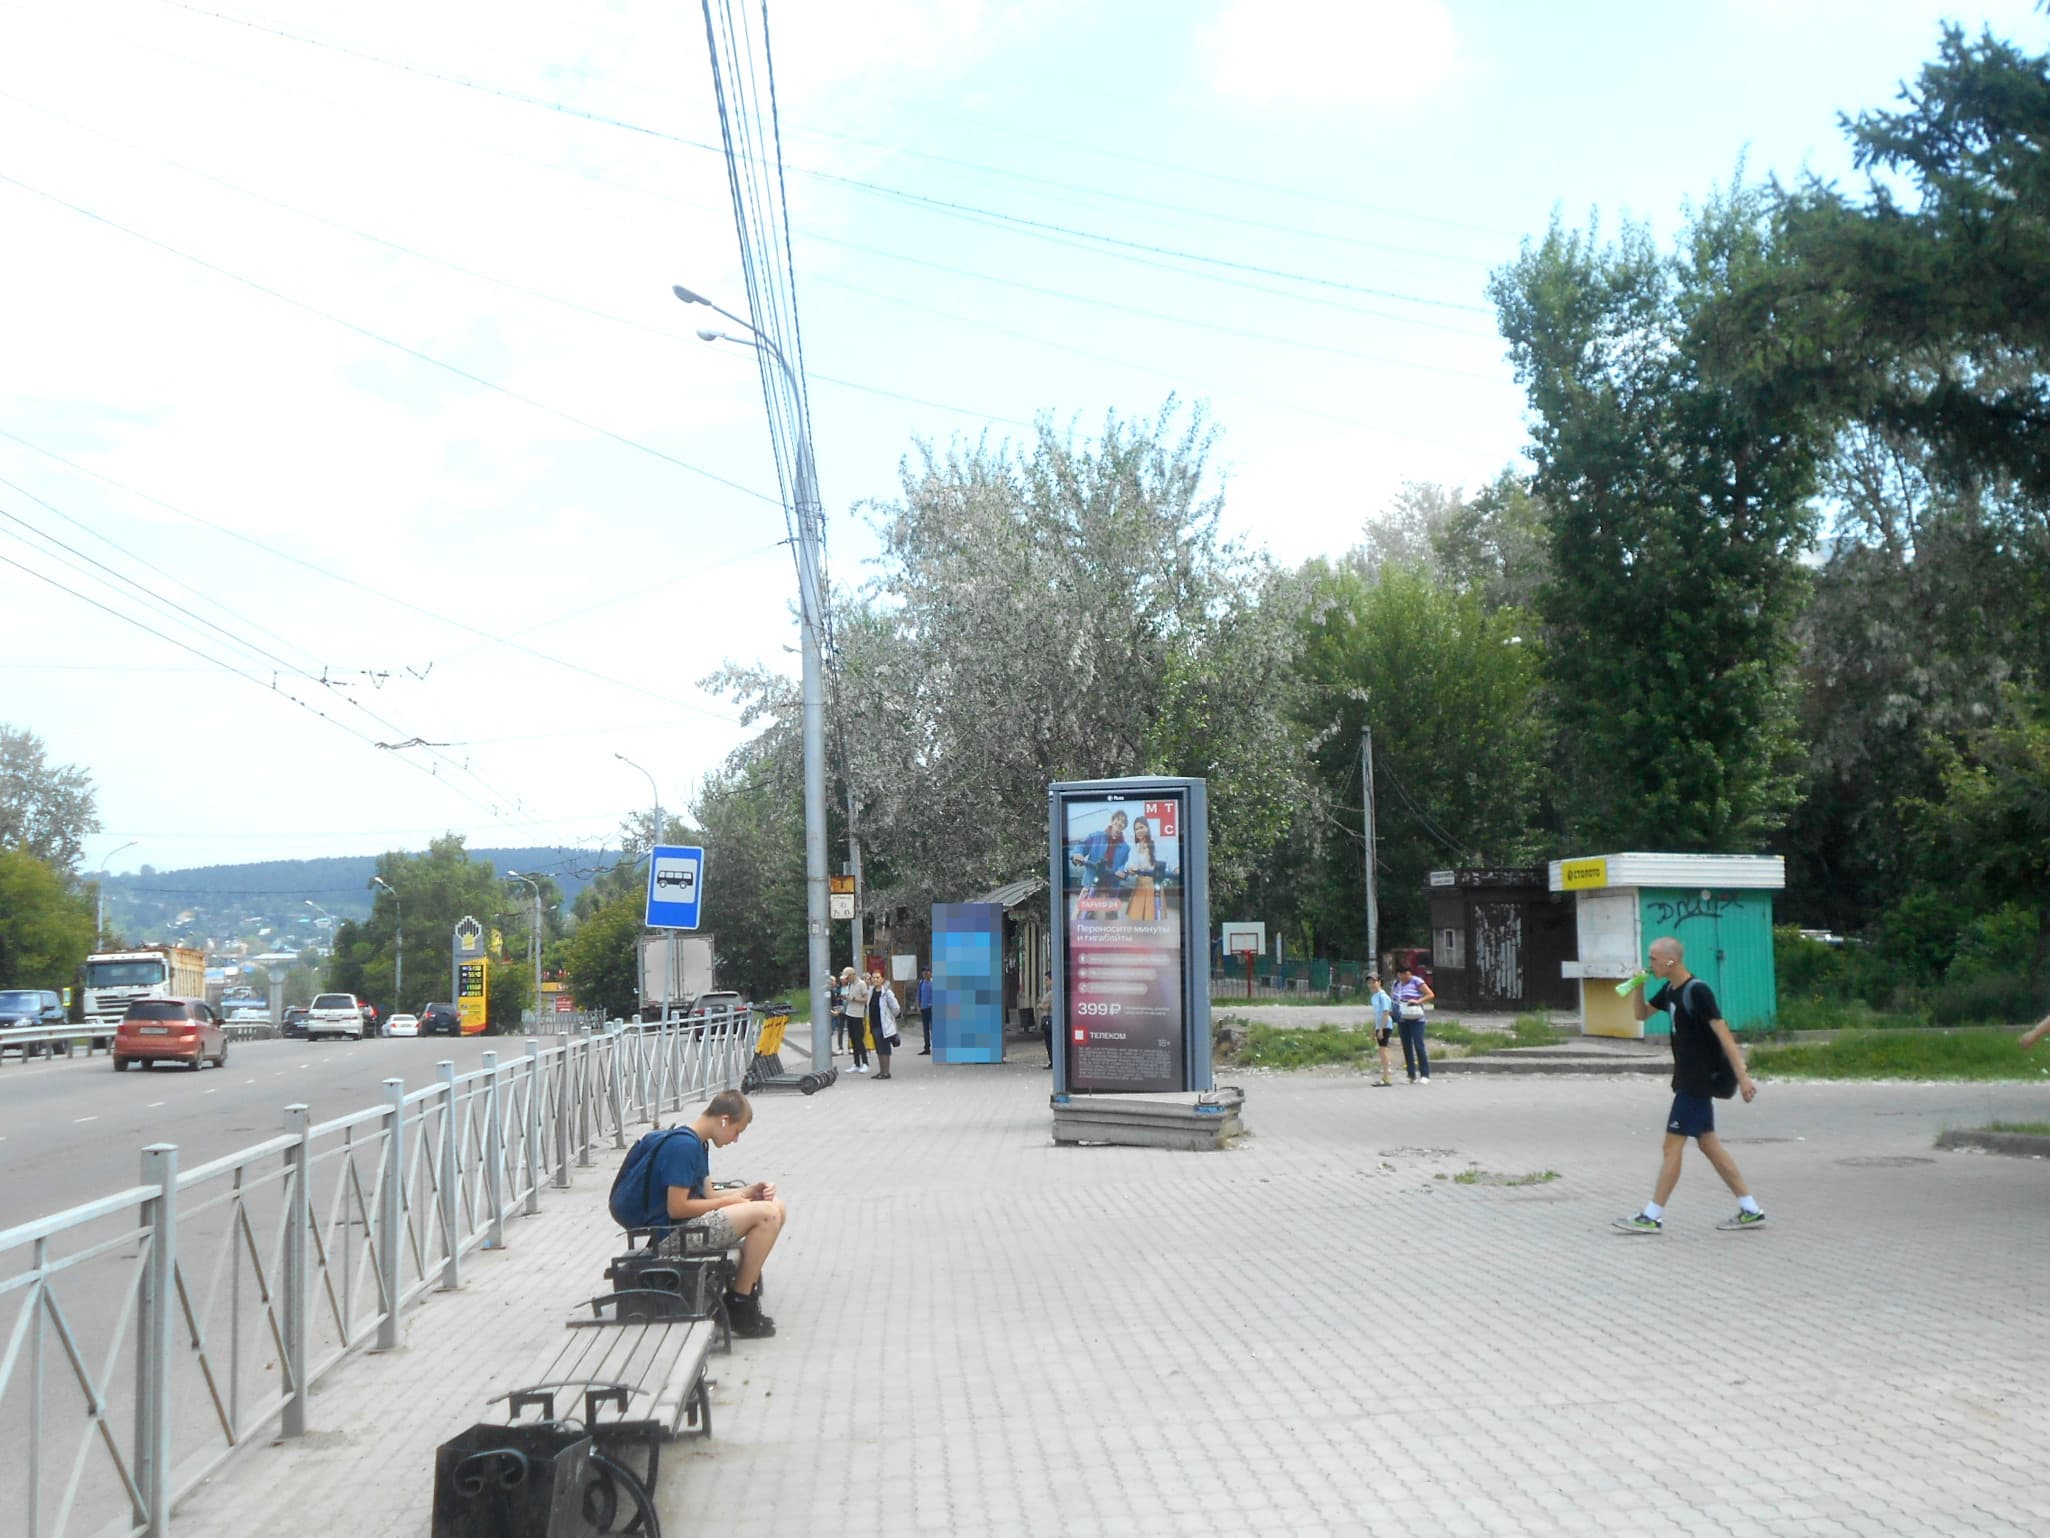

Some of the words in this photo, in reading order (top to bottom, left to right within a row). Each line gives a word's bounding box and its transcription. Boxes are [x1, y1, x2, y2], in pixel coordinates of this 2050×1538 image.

[1077, 924, 1132, 934] Переносите
[1134, 925, 1170, 936] минуты
[1085, 933, 1133, 943] гигабайты
[1089, 1031, 1127, 1040] ТЕЛЕКОМ
